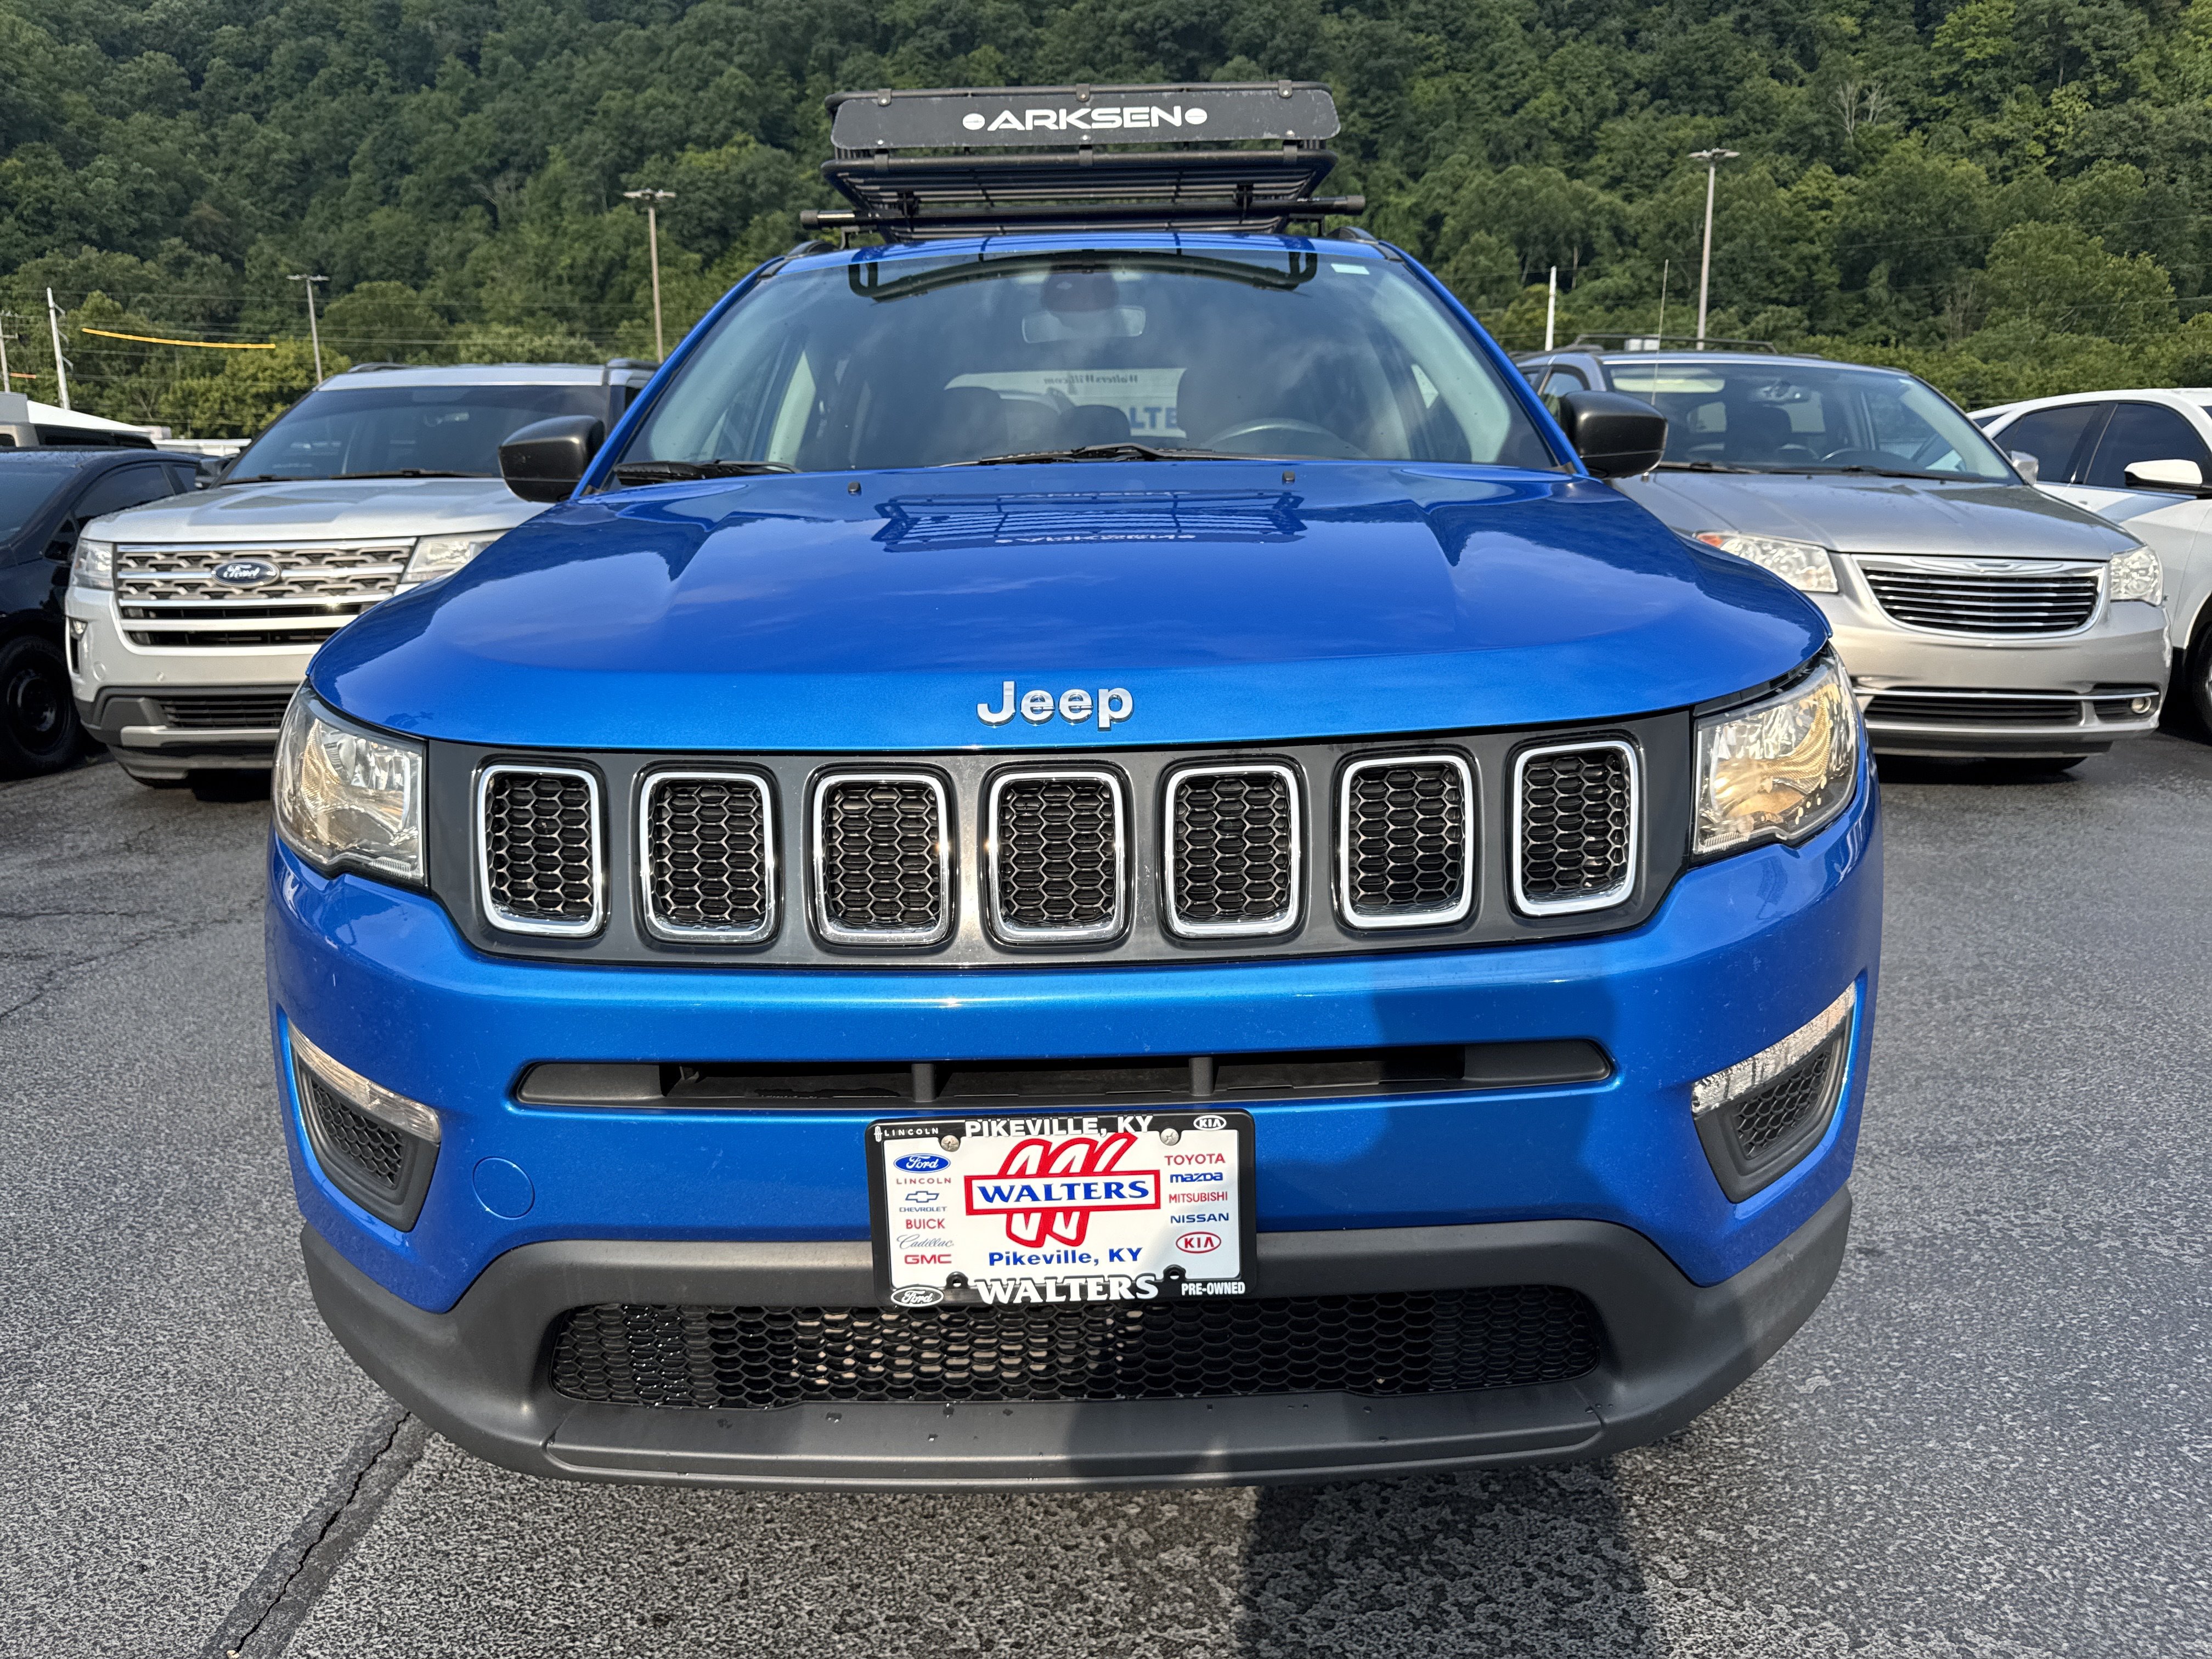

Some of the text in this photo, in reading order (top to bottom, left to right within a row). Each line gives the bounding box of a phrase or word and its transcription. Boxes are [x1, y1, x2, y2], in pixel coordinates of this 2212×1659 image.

[987, 105, 1182, 131] ARKSEN
[977, 681, 1134, 731] Jeep
[965, 1115, 1153, 1138] PIKEVILLE, KY
[1199, 1119, 1221, 1127] KIA
[884, 1127, 939, 1137] LINCOLN
[906, 1155, 939, 1169] Ford
[1164, 1153, 1226, 1166] TOYOTA
[1170, 1172, 1223, 1183] mazda
[977, 1181, 1149, 1204] WALTERS
[1169, 1191, 1228, 1204] MITSUBISHI
[905, 1218, 946, 1229] BUICK
[1170, 1212, 1229, 1224] NISSAN
[896, 1234, 955, 1250] Cadillac
[1184, 1237, 1215, 1249] KIA
[904, 1254, 952, 1265] GMC
[989, 1247, 1143, 1266] Pikeville, KY
[974, 1275, 1159, 1305] WALTERS
[1181, 1282, 1245, 1296] PRE-OWNED
[901, 1290, 933, 1304] Ford
